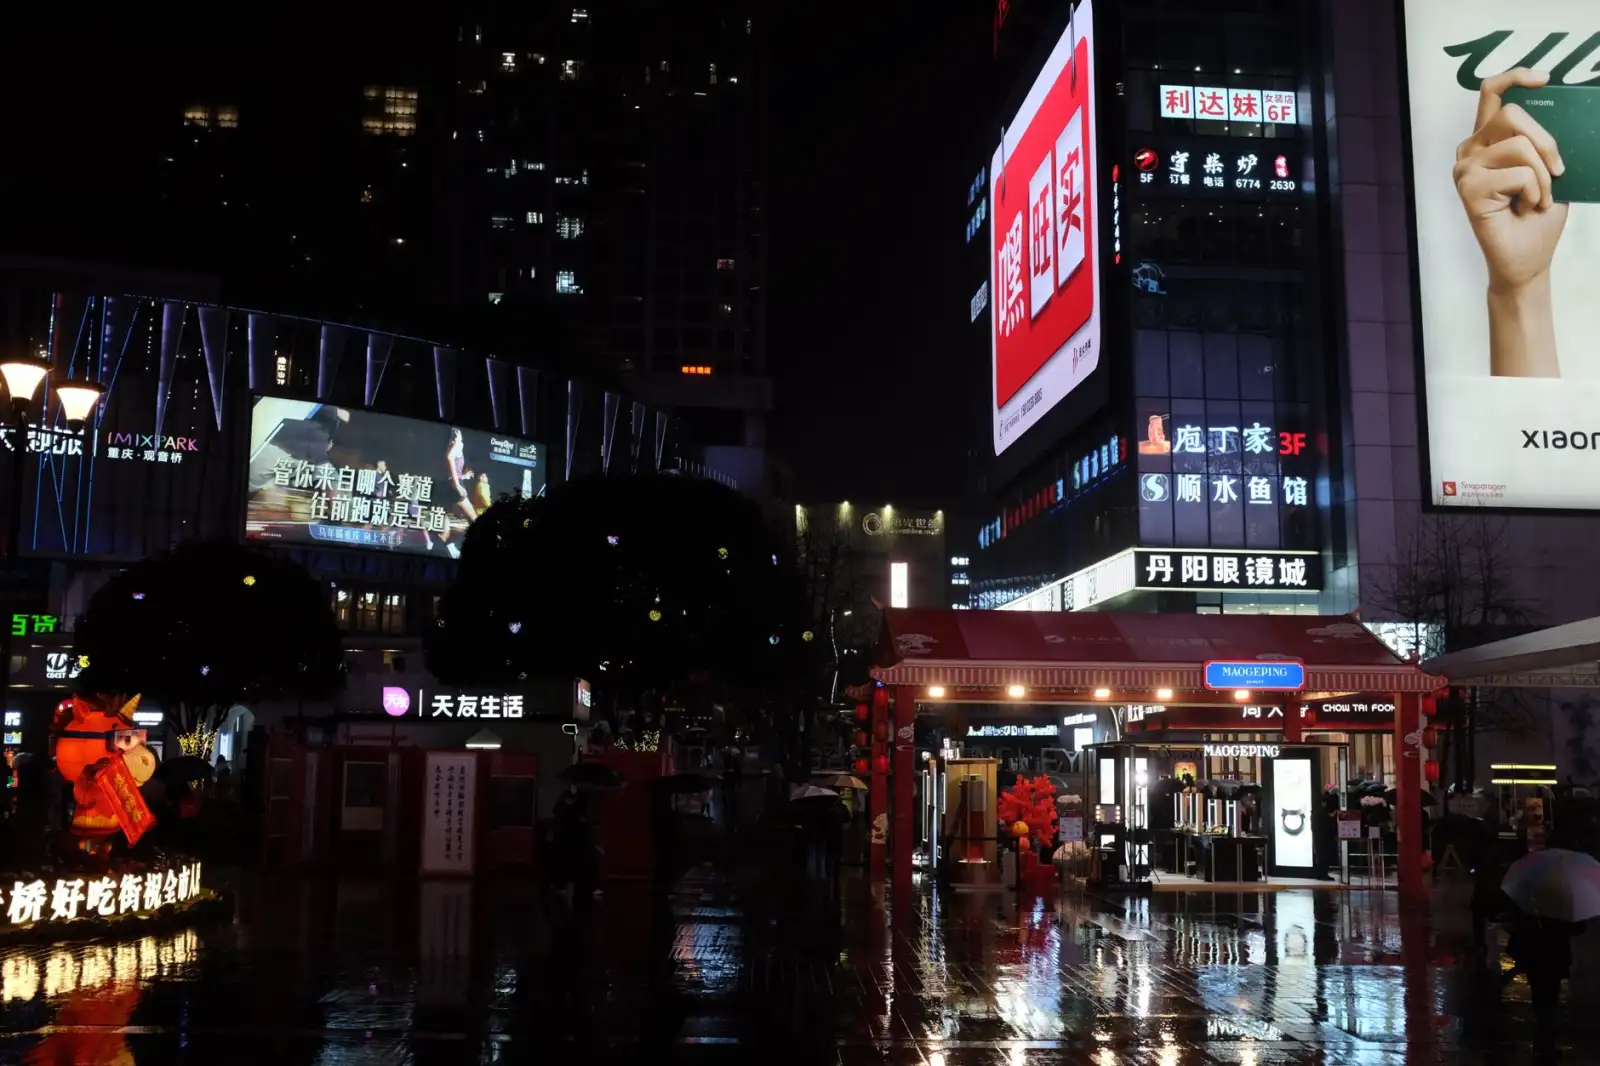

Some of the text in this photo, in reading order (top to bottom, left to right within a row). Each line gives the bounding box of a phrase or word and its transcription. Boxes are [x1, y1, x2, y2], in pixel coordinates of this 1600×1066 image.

[1165, 90, 1258, 117] 利达妹
[1264, 94, 1293, 104] 女装店
[1267, 105, 1291, 121] 6F
[1140, 173, 1153, 183] 5F
[1169, 174, 1295, 191] 订餐 电话 6774 2630
[1173, 422, 1273, 454] 庖丁家
[1279, 432, 1307, 456] 3F
[1521, 430, 1600, 450] xiao
[273, 458, 434, 502] 管你来自哪个赛道
[1176, 474, 1307, 506] 顺水鱼馆
[1460, 481, 1506, 491] Snapdragon
[310, 491, 446, 532] 往前跑就是王道
[1145, 555, 1307, 586] 丹阳眼镜城
[1222, 666, 1288, 677] MAOGEPING
[432, 695, 524, 718] 天友生活
[1322, 703, 1350, 713] CHOW
[1352, 703, 1368, 713] TAI
[1203, 744, 1280, 757] MAOGEPING
[0, 862, 201, 924] 桥好吃街祝全市人民
